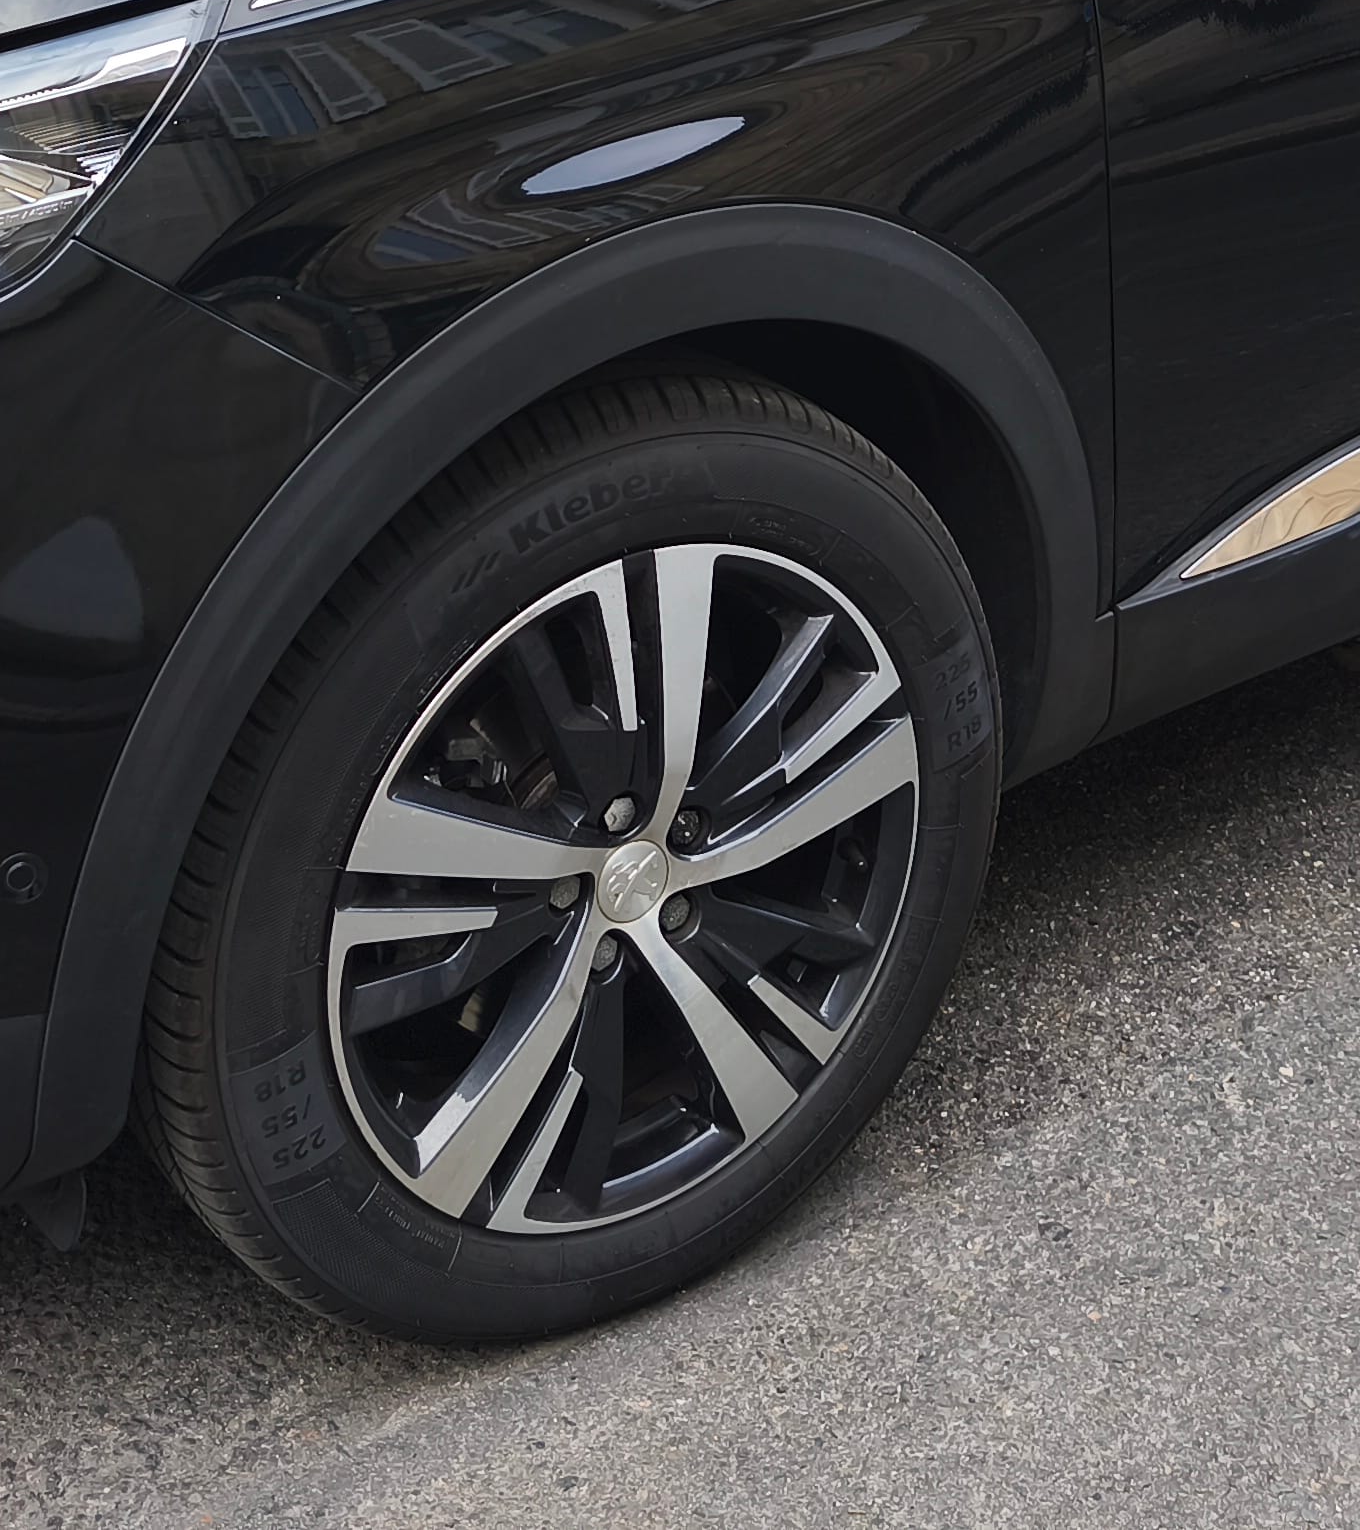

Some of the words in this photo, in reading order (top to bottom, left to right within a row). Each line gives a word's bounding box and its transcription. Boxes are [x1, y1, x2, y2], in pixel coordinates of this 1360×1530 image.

[508, 469, 673, 554] Kleber
[934, 651, 972, 692] 225
[946, 714, 982, 752] R18
[253, 1059, 308, 1103] R18
[271, 1123, 328, 1171] 225
